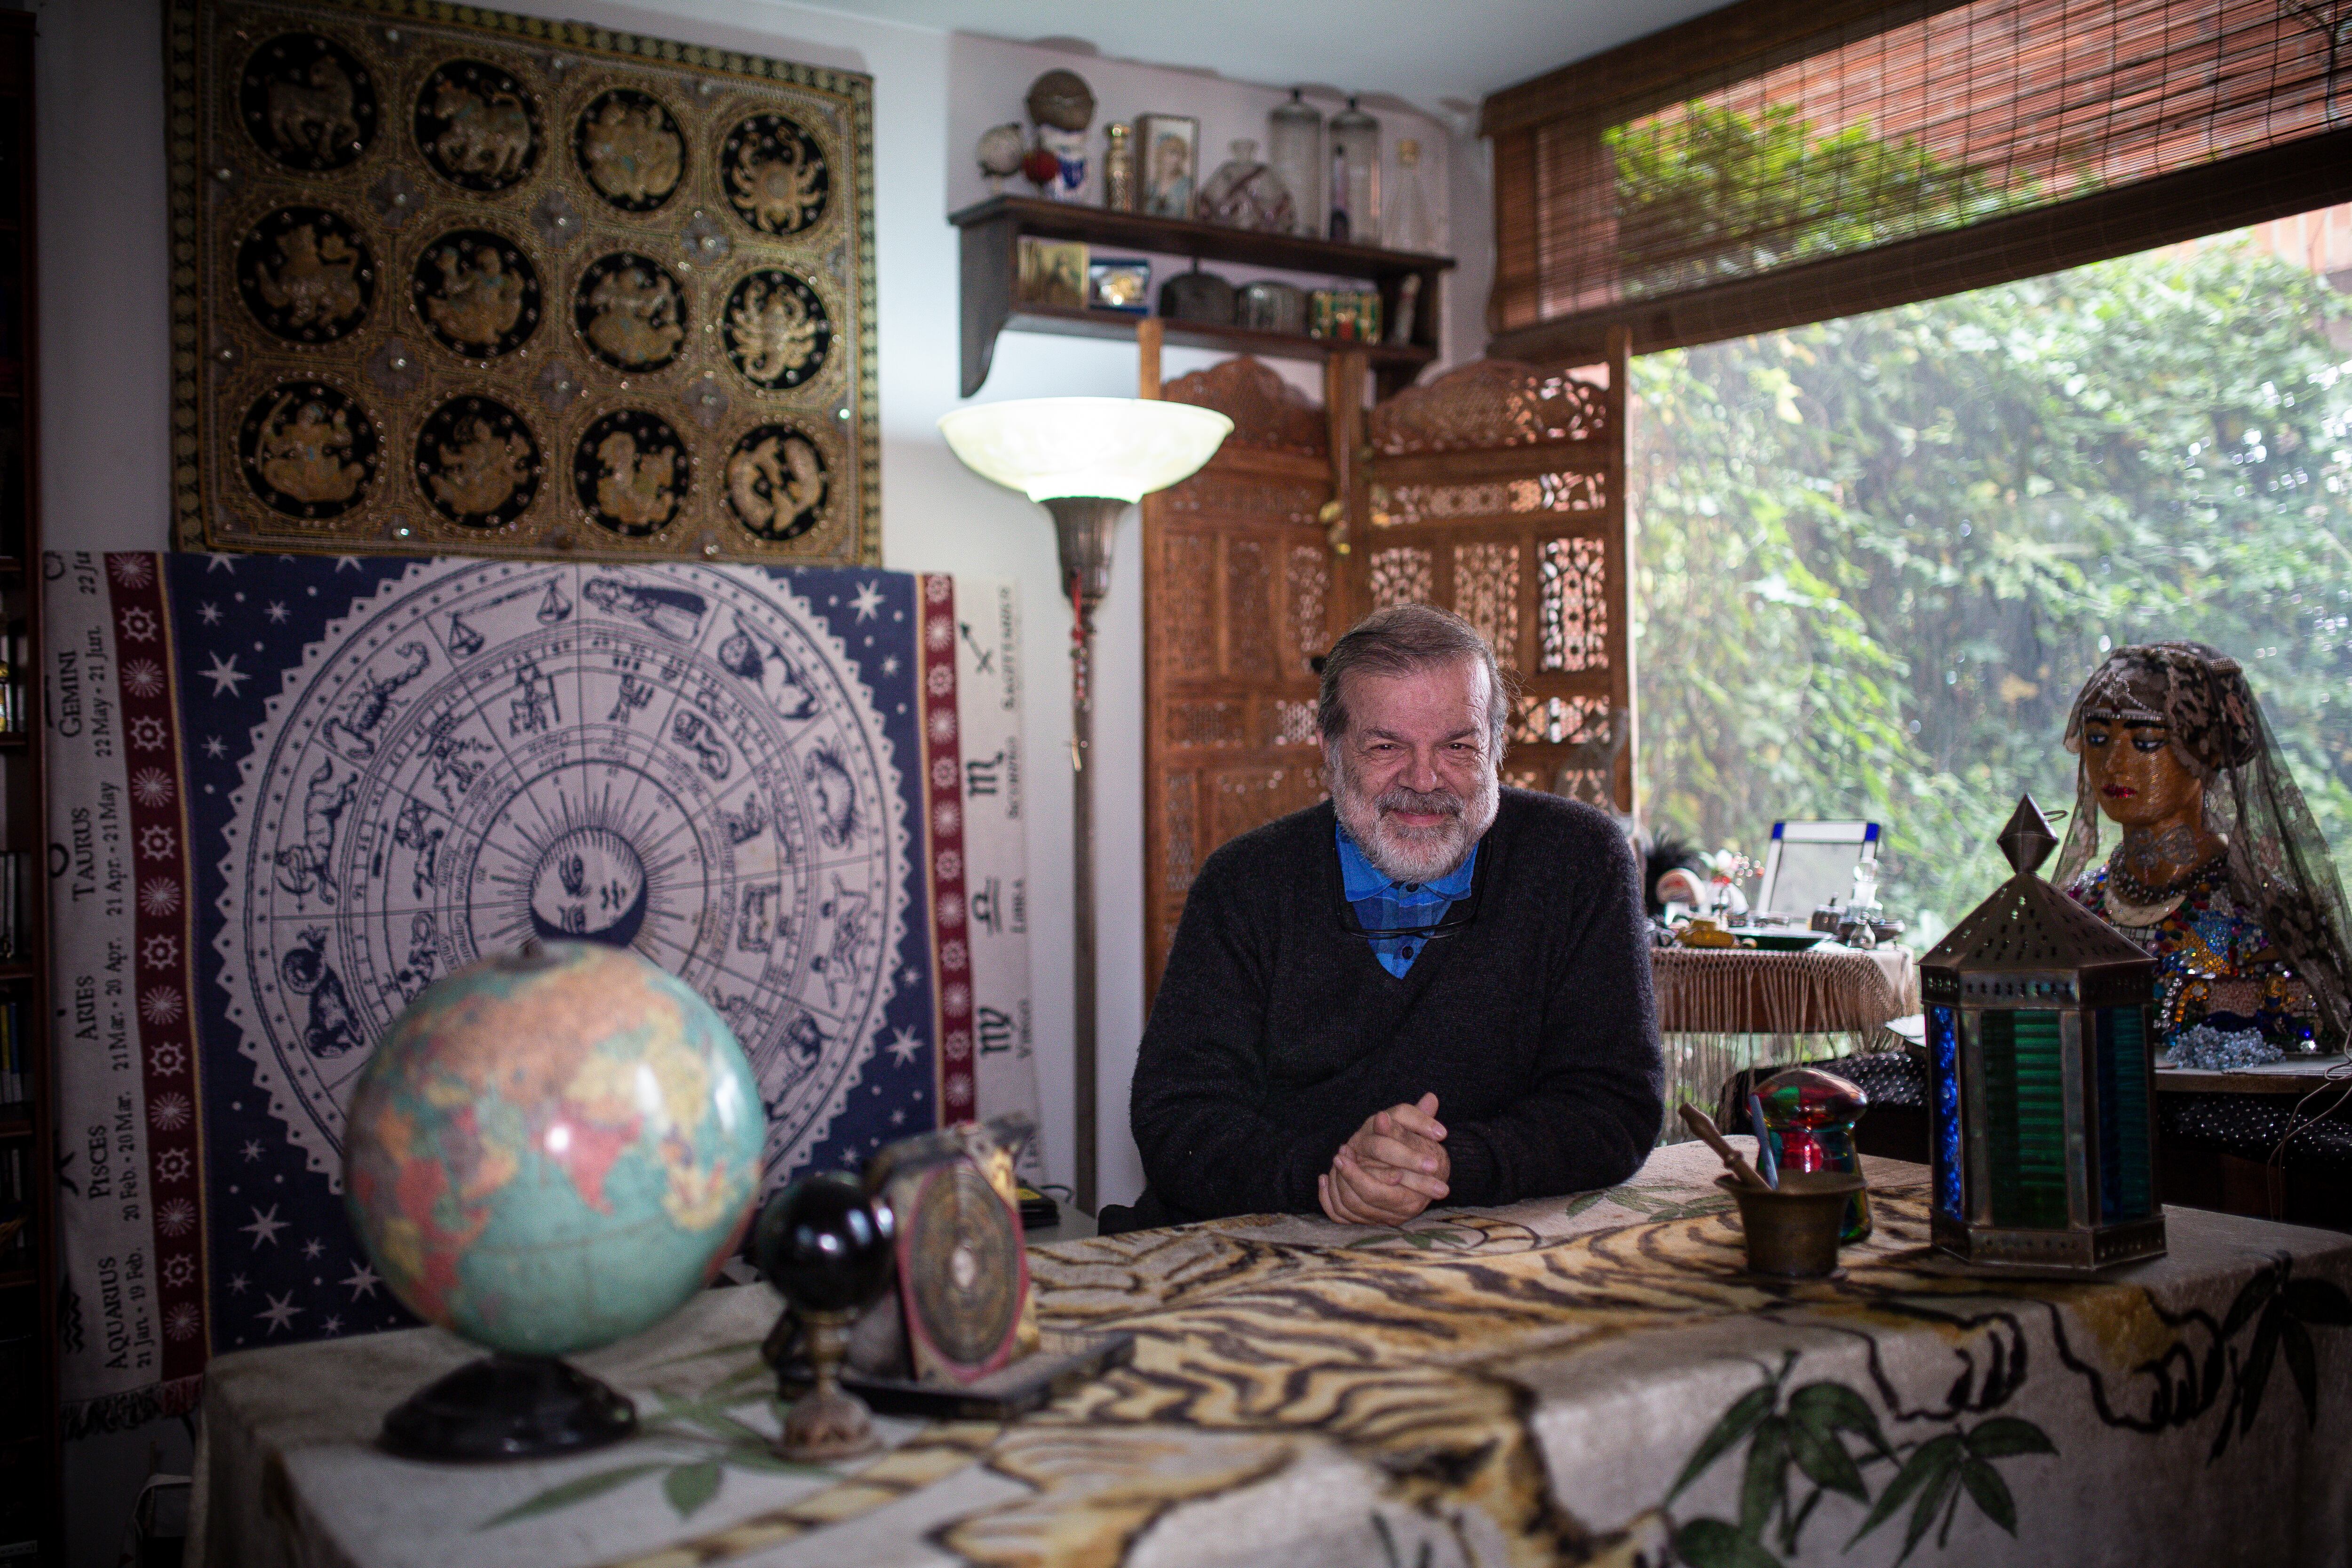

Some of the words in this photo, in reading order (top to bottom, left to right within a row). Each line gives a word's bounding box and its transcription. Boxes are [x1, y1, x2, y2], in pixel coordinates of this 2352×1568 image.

[78, 575, 96, 594] 22
[88, 666, 105, 682] 21
[58, 650, 83, 737] GEMINI
[90, 697, 113, 736] May
[94, 738, 113, 757] 22
[97, 781, 121, 820] May
[102, 824, 119, 842] 21
[71, 807, 95, 902] TAURUS
[105, 898, 123, 916] 21
[105, 979, 122, 996] 20
[74, 975, 99, 1041] ARIES
[111, 1053, 129, 1071] 21
[117, 1133, 135, 1153] 20
[87, 1124, 111, 1200] PISCES
[122, 1204, 140, 1221] 20
[128, 1285, 146, 1301] 19
[97, 1256, 130, 1369] AQUARIUS
[136, 1351, 152, 1369] 21
